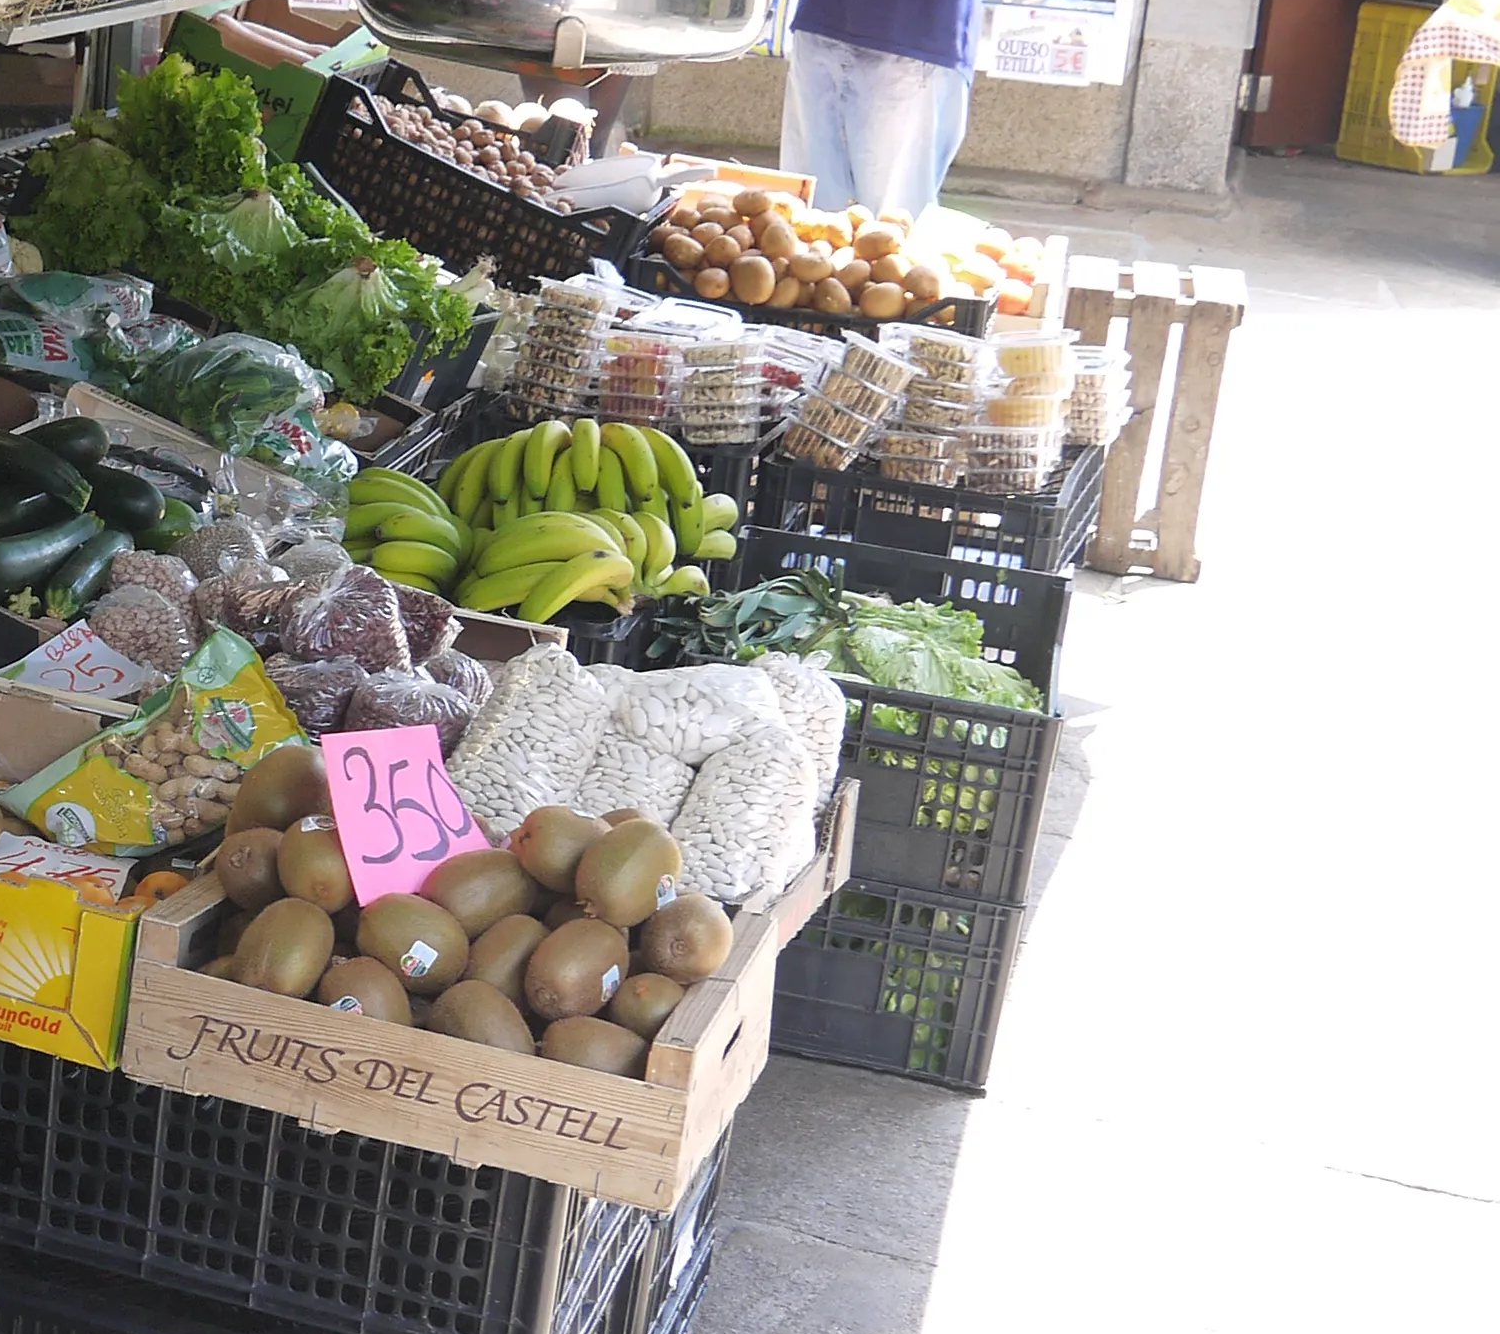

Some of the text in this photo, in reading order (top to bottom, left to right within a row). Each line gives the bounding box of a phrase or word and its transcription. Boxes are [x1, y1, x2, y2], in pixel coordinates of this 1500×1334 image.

[997, 38, 1050, 57] QUESO
[995, 55, 1047, 76] TETILLA
[1054, 51, 1083, 72] 5€
[342, 745, 474, 865] 350
[167, 1015, 629, 1151] FRUITS DEL CASTELL
